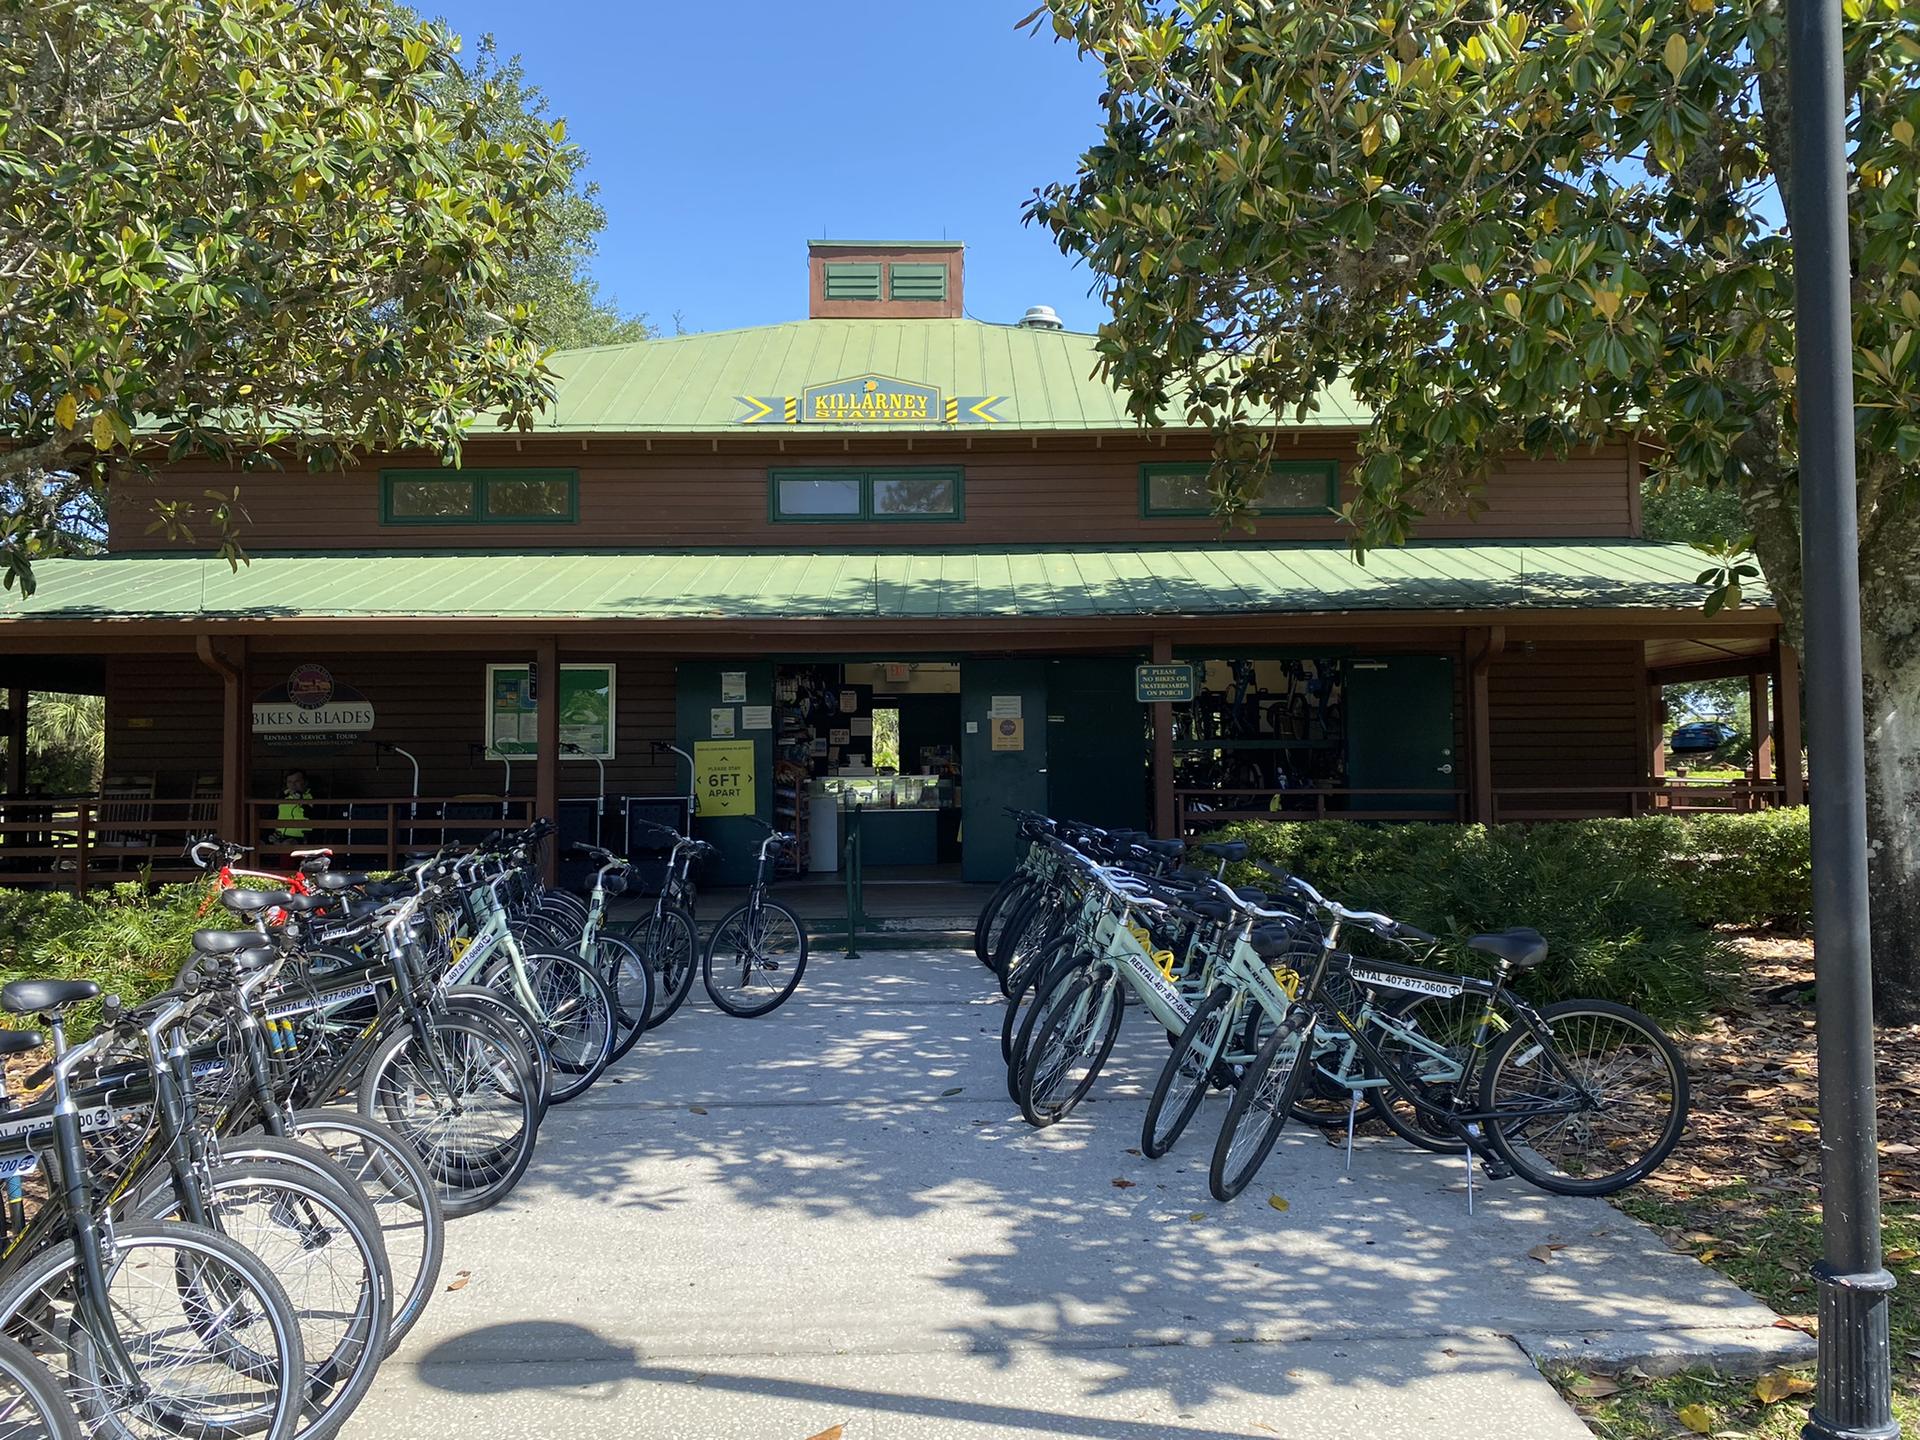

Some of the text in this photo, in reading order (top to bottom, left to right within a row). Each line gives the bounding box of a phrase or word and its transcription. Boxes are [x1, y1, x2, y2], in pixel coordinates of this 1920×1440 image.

[815, 393, 929, 409] KILLARNEY
[815, 410, 928, 418] STATION
[252, 710, 371, 725] BIKES & BLADES
[708, 773, 741, 787] 6FT
[708, 789, 742, 798] APART
[1351, 968, 1382, 982] ENTAL
[1385, 975, 1447, 994] 407-877-0600
[1129, 956, 1194, 1022] RENTAL 407-877-0600
[268, 1000, 303, 1016] RENTAL
